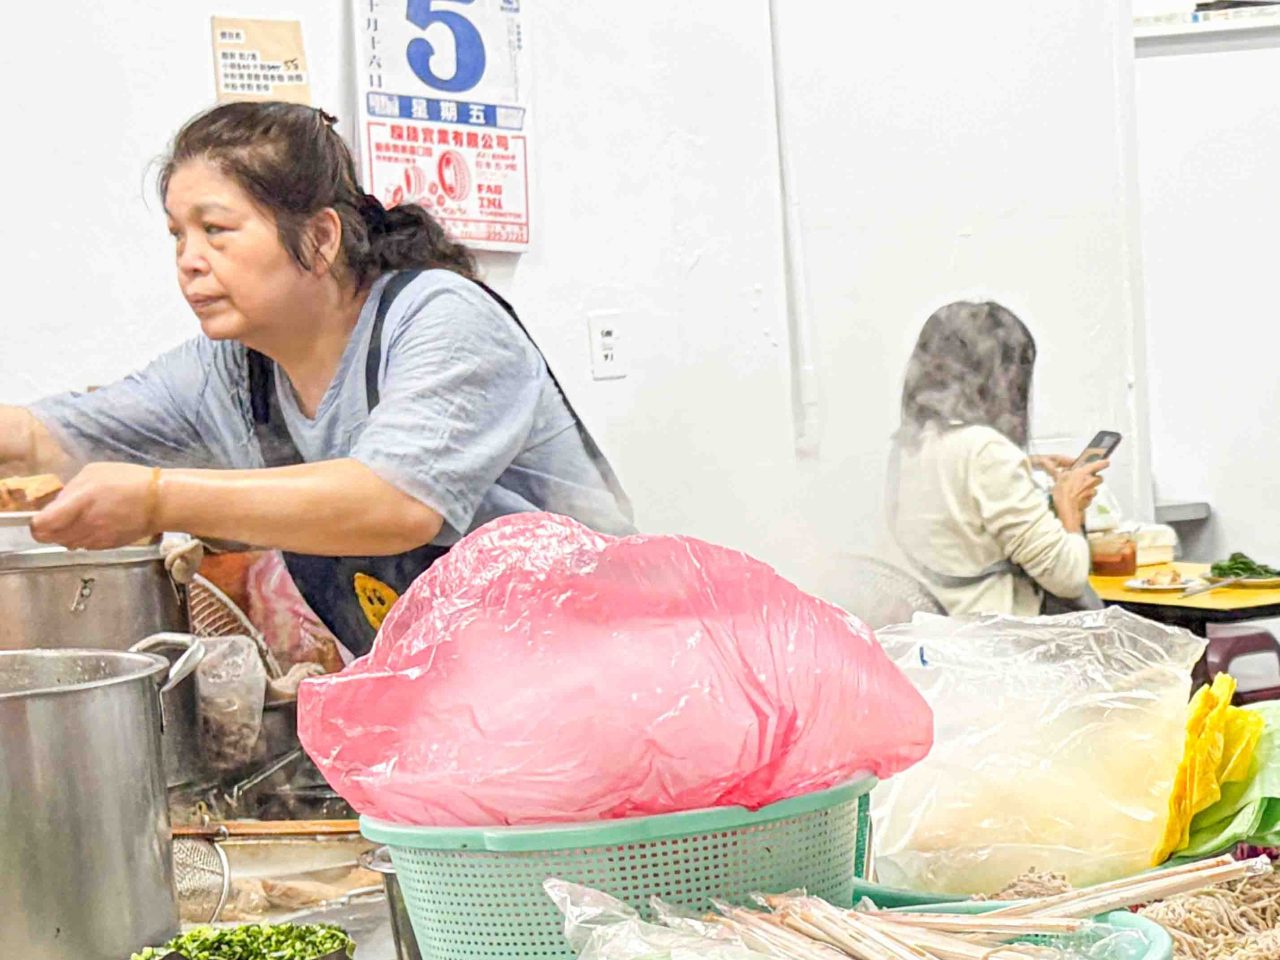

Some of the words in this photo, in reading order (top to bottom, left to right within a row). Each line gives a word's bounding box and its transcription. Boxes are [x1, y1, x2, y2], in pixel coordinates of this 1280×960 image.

[406, 0, 487, 93] 5
[411, 97, 486, 125] 星期五
